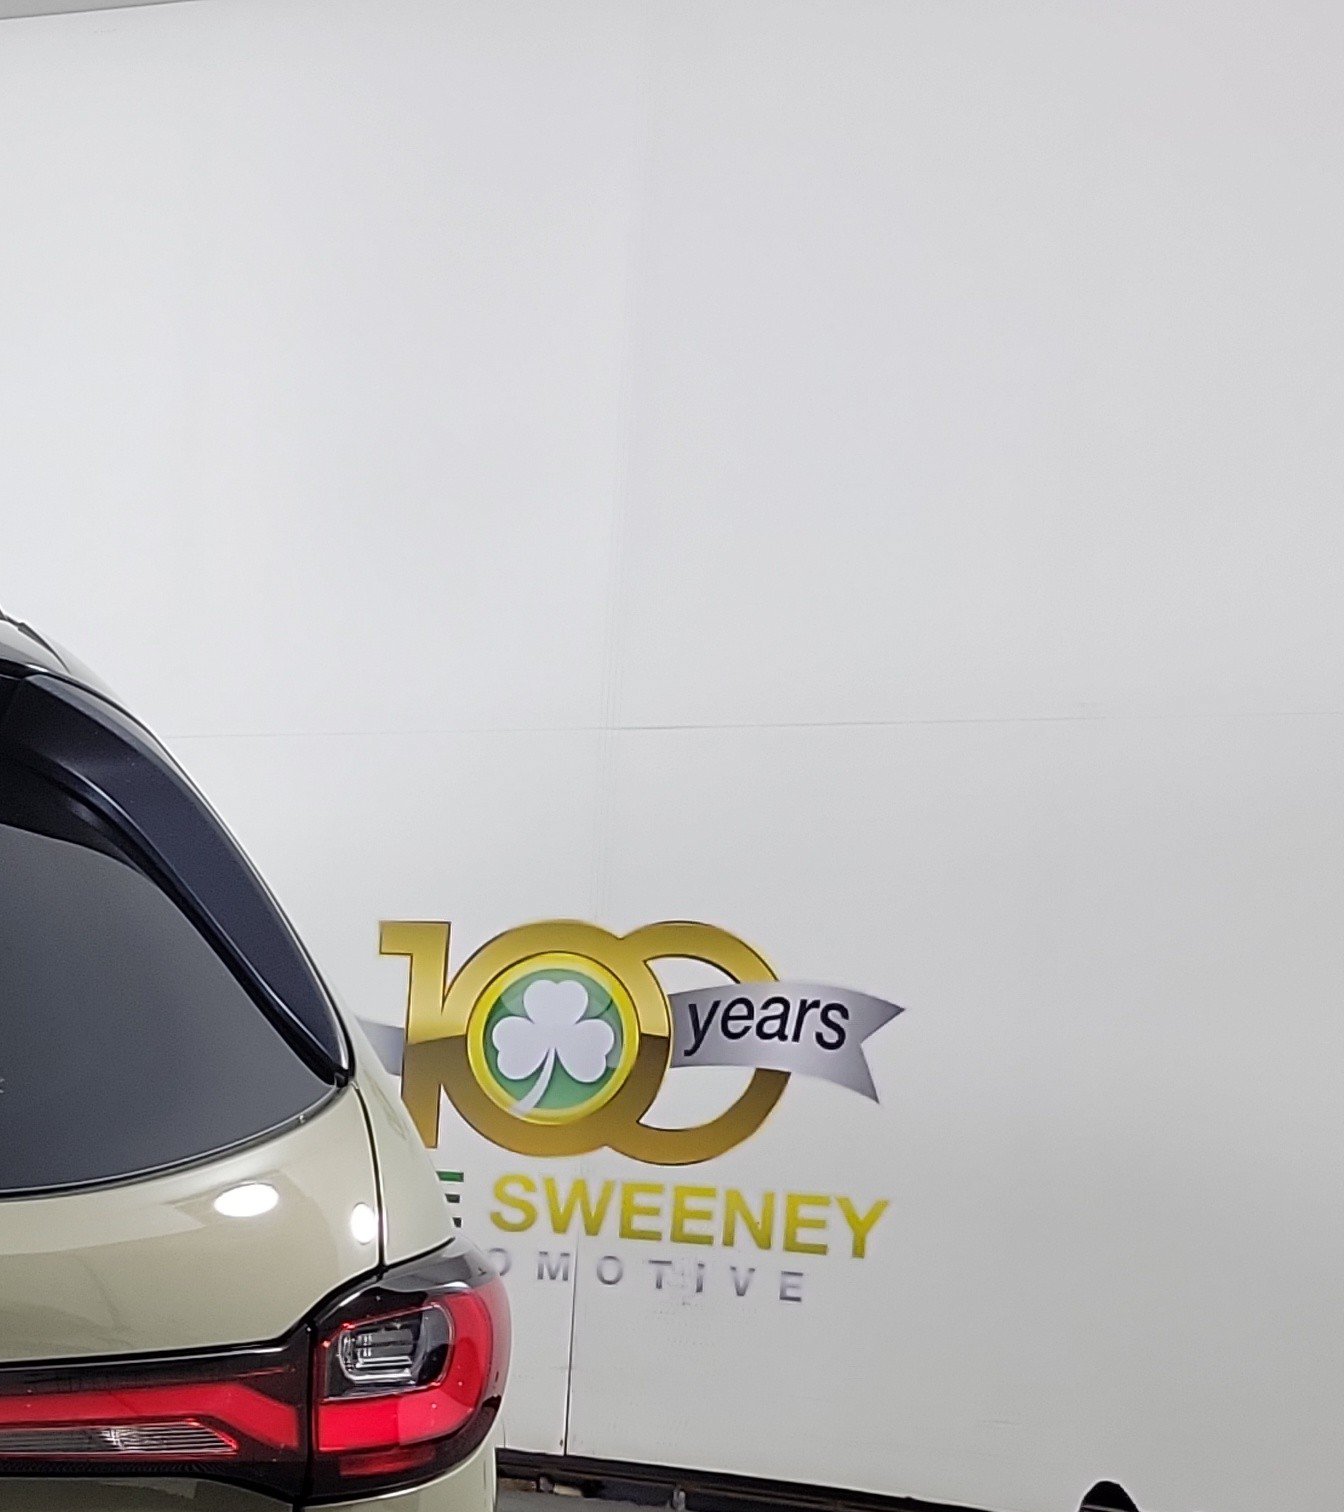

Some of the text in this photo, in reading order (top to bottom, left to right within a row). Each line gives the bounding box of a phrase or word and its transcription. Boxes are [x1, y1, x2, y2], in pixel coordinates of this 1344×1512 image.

[378, 918, 850, 1166] 100 years
[488, 1173, 891, 1259] SWEENEY
